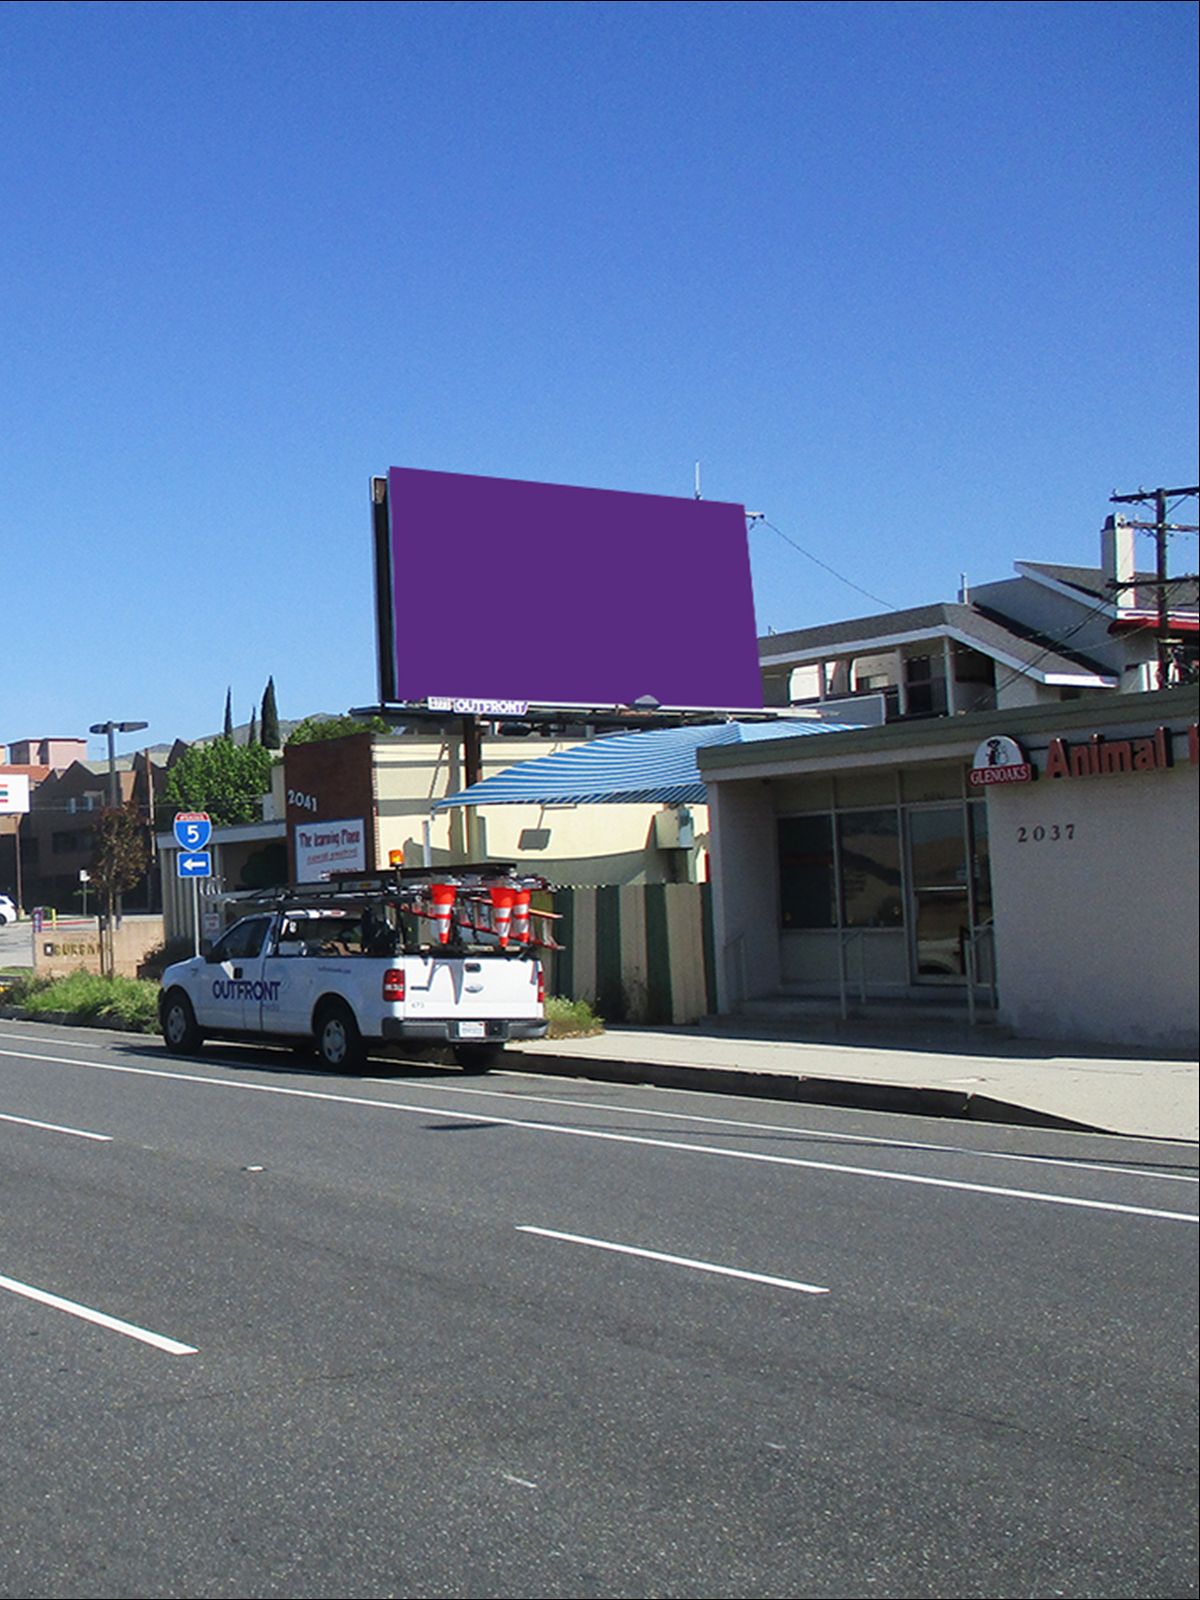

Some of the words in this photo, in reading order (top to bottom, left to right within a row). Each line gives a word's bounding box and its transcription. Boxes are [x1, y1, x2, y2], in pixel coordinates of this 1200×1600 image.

[454, 699, 528, 715] OUTFRONT
[1047, 726, 1167, 778] Animal
[970, 766, 1029, 785] GLENOAKS
[287, 789, 317, 812] 2041
[187, 825, 200, 843] 5
[1017, 824, 1076, 842] 2037
[54, 942, 111, 956] BURBA
[212, 979, 281, 1001] OUTFRONT
